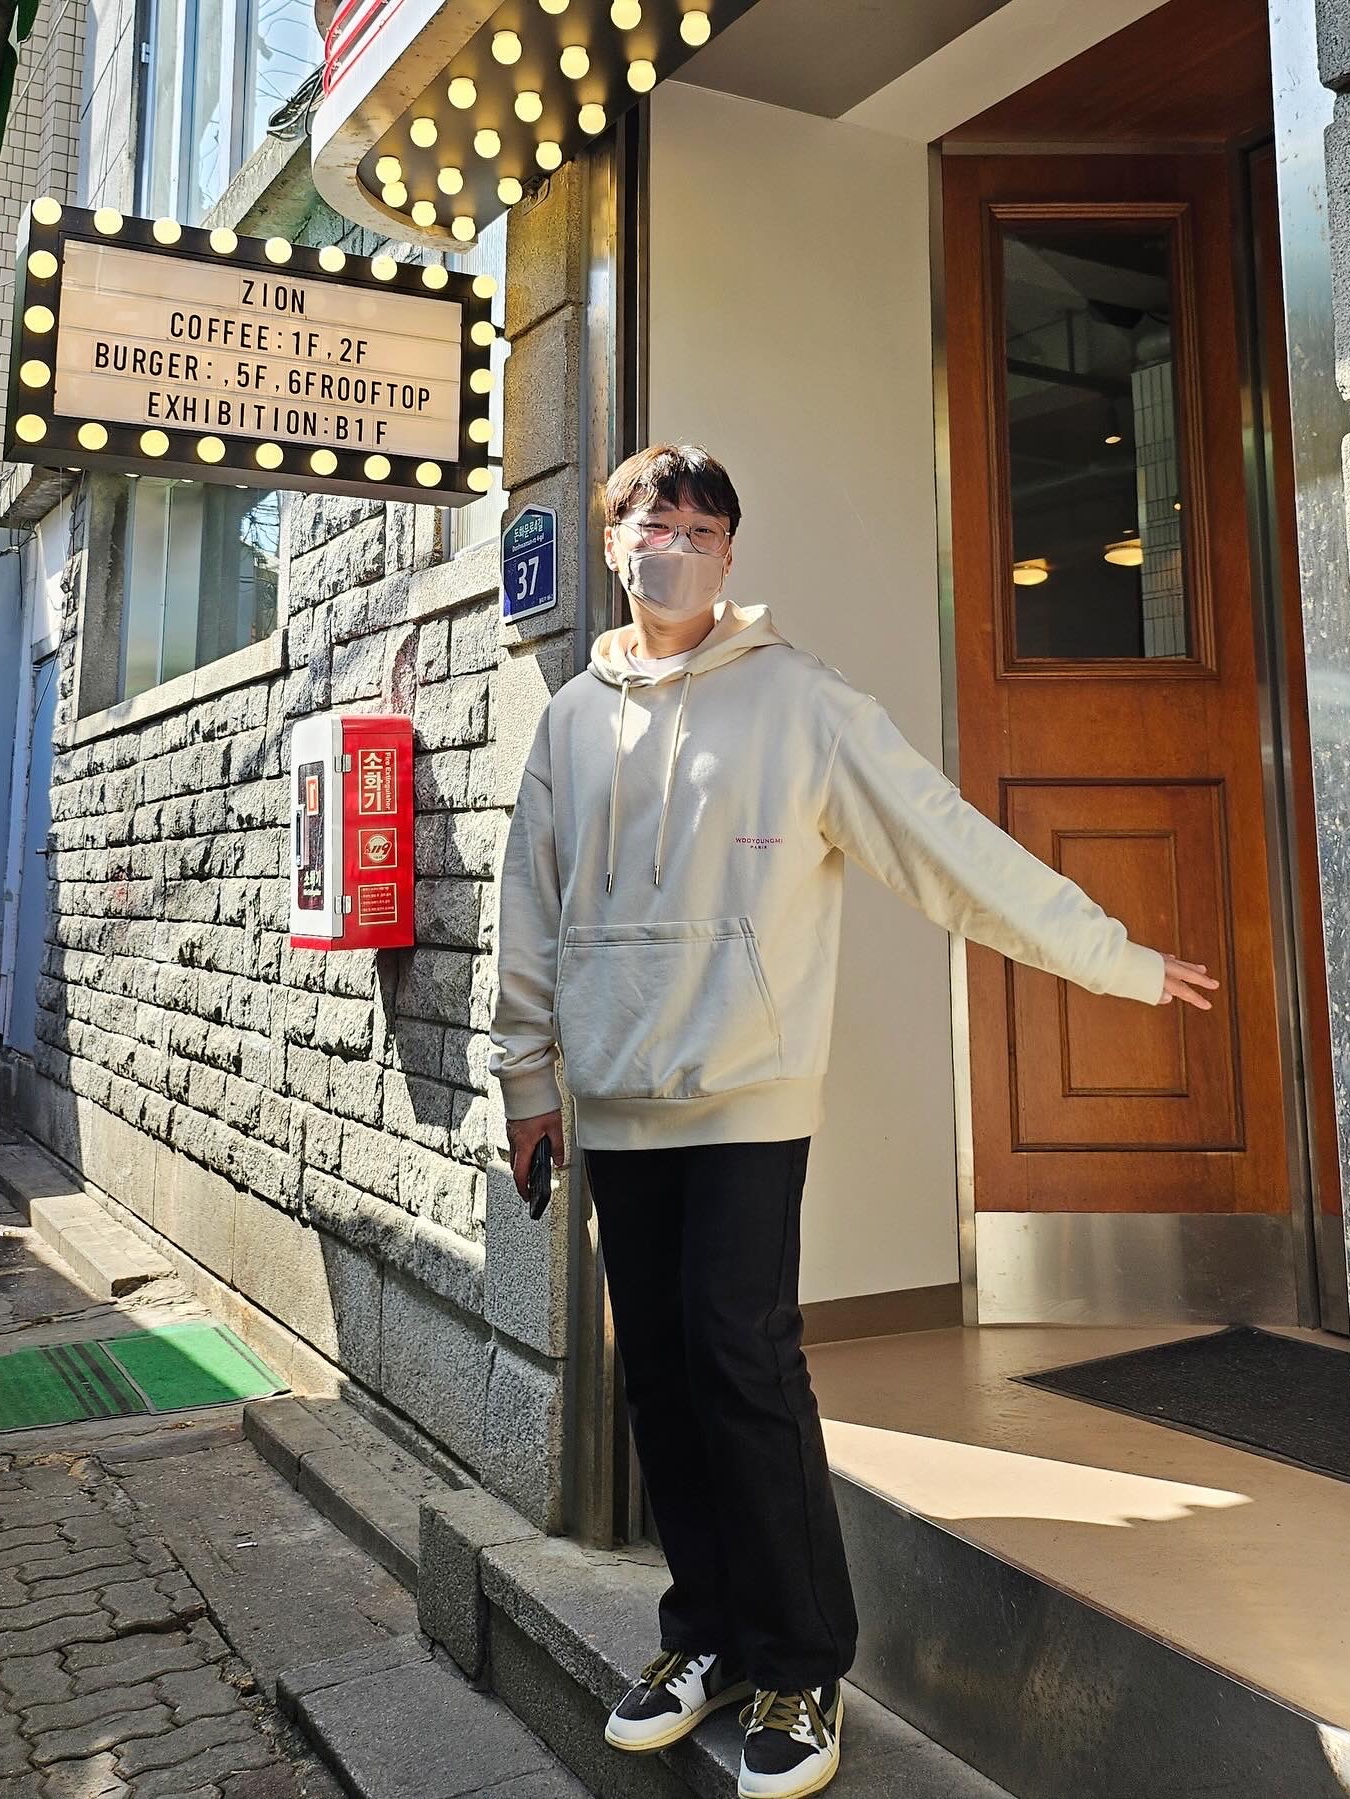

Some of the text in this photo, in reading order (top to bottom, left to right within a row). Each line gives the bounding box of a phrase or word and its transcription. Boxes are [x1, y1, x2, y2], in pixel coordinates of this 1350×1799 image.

[241, 279, 306, 315] ZION
[517, 556, 539, 600] 37
[363, 752, 383, 811] 소화기
[384, 752, 392, 810] Fire Extinguisher
